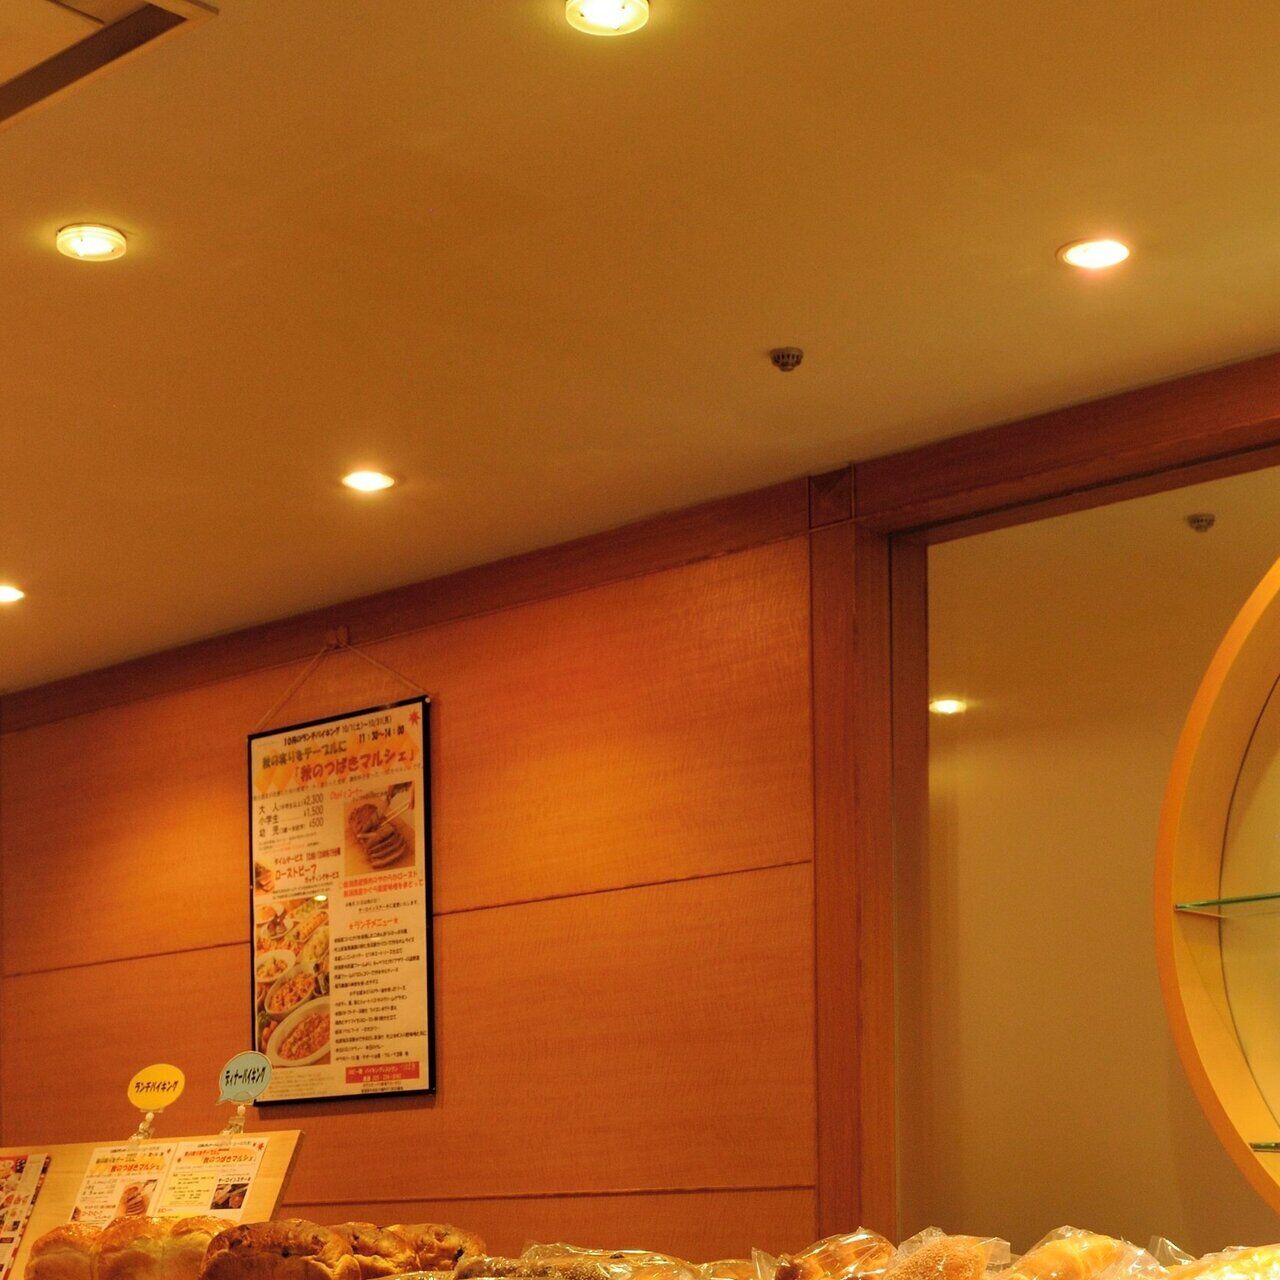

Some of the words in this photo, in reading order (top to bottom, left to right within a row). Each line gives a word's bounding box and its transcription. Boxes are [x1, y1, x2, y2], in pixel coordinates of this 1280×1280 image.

[135, 1081, 179, 1093] ランチバイキング
